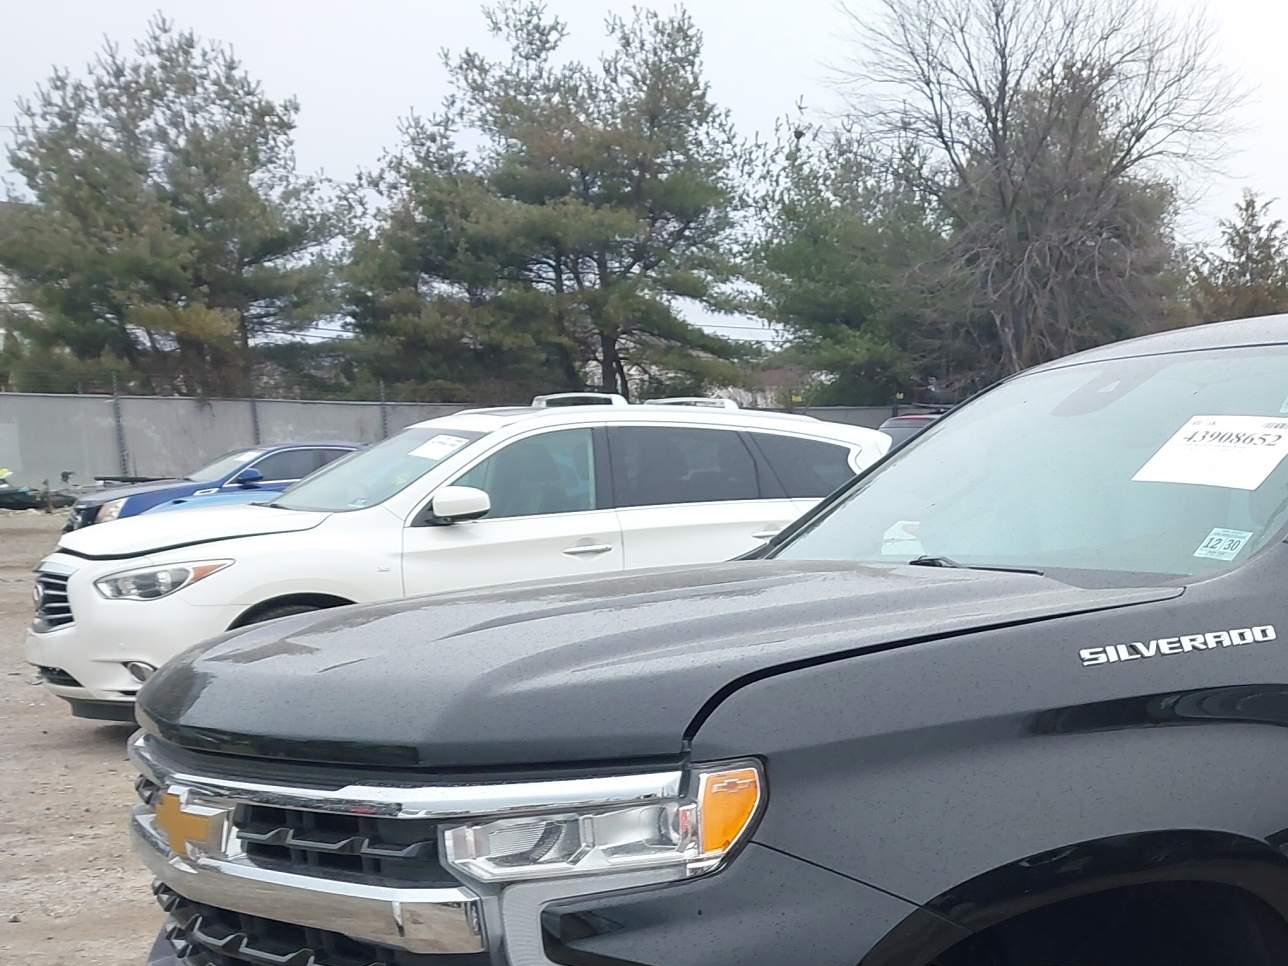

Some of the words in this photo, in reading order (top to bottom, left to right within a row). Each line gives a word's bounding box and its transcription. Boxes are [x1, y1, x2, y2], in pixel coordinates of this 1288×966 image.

[1183, 430, 1283, 447] 43908652
[1202, 537, 1223, 549] 12
[1223, 539, 1241, 551] 30
[1079, 624, 1277, 666] SILVERADO
